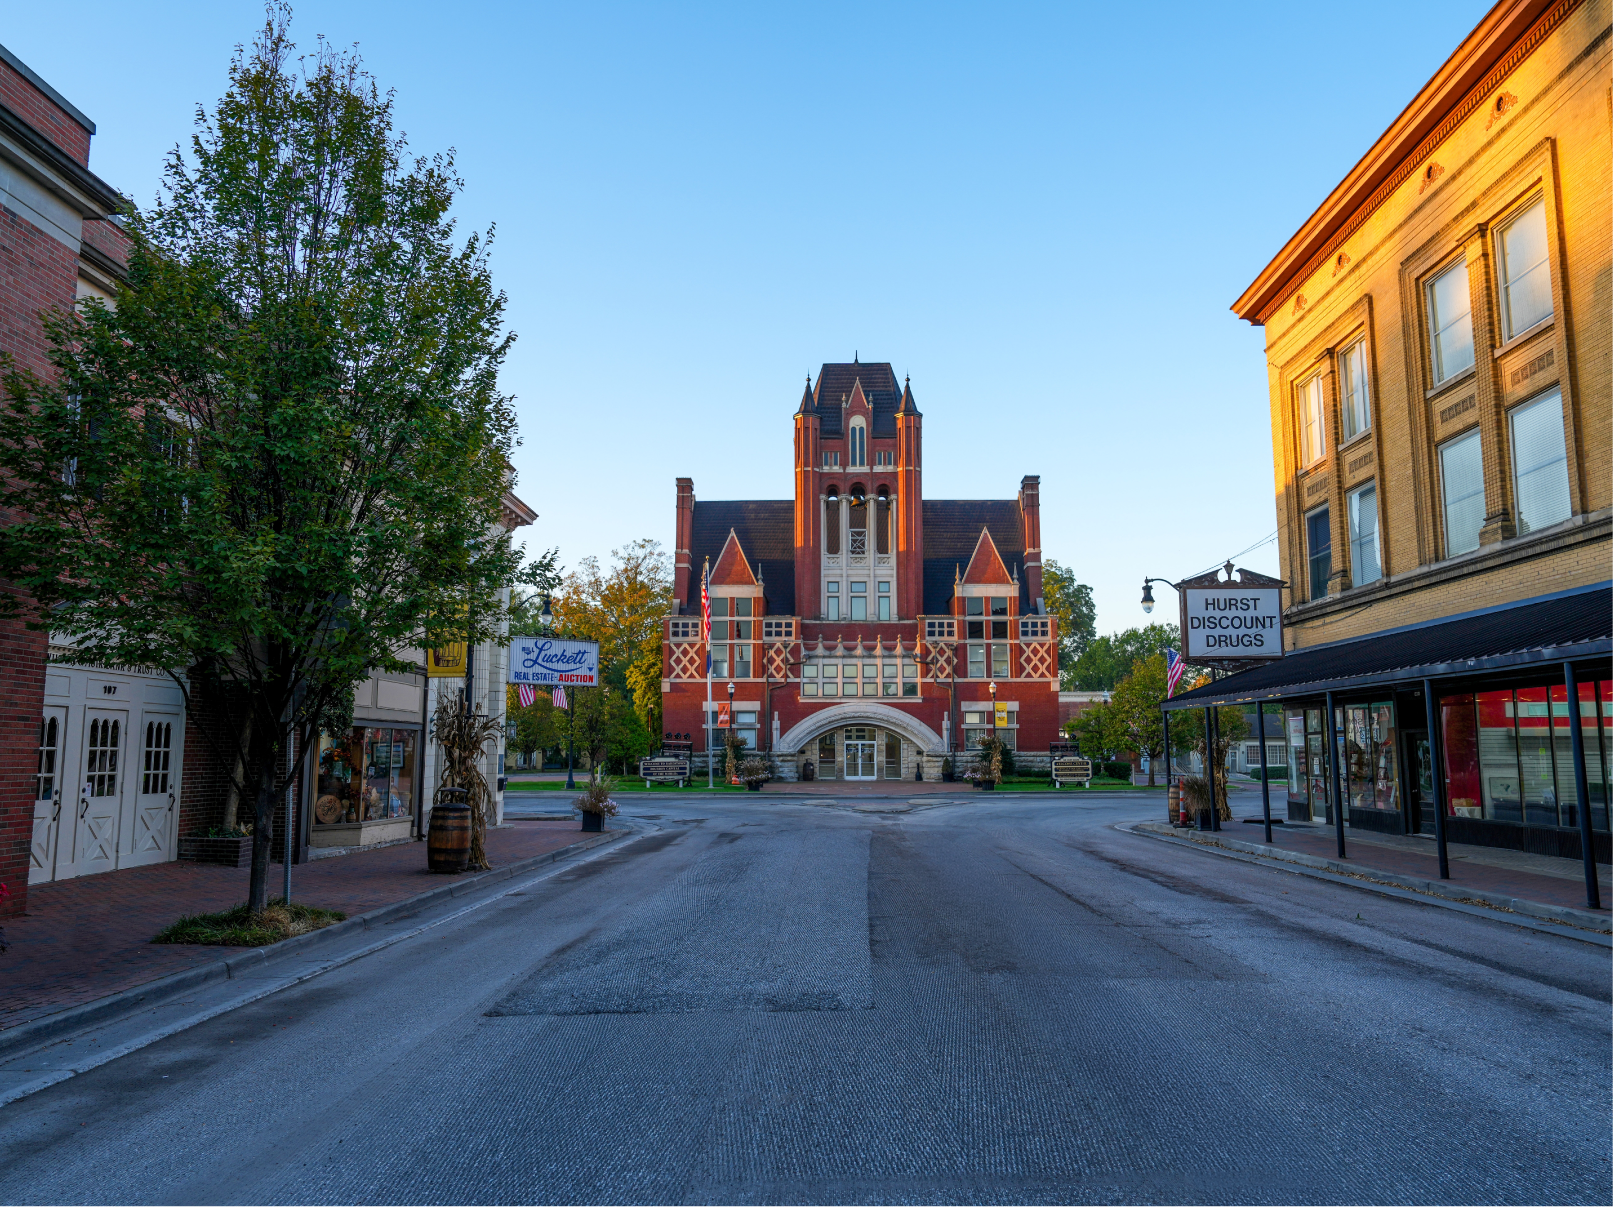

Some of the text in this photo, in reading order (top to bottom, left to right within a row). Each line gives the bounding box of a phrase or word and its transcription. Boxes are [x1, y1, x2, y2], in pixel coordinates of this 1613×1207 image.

[1205, 598, 1260, 611] HURST
[1190, 616, 1276, 629] DISCOUNT
[1206, 634, 1264, 647] DRUGS
[523, 640, 591, 673] Luckett
[134, 664, 153, 675] TRUST
[514, 671, 531, 681] REAL
[558, 673, 594, 683] AUCTION
[103, 684, 117, 695] 107
